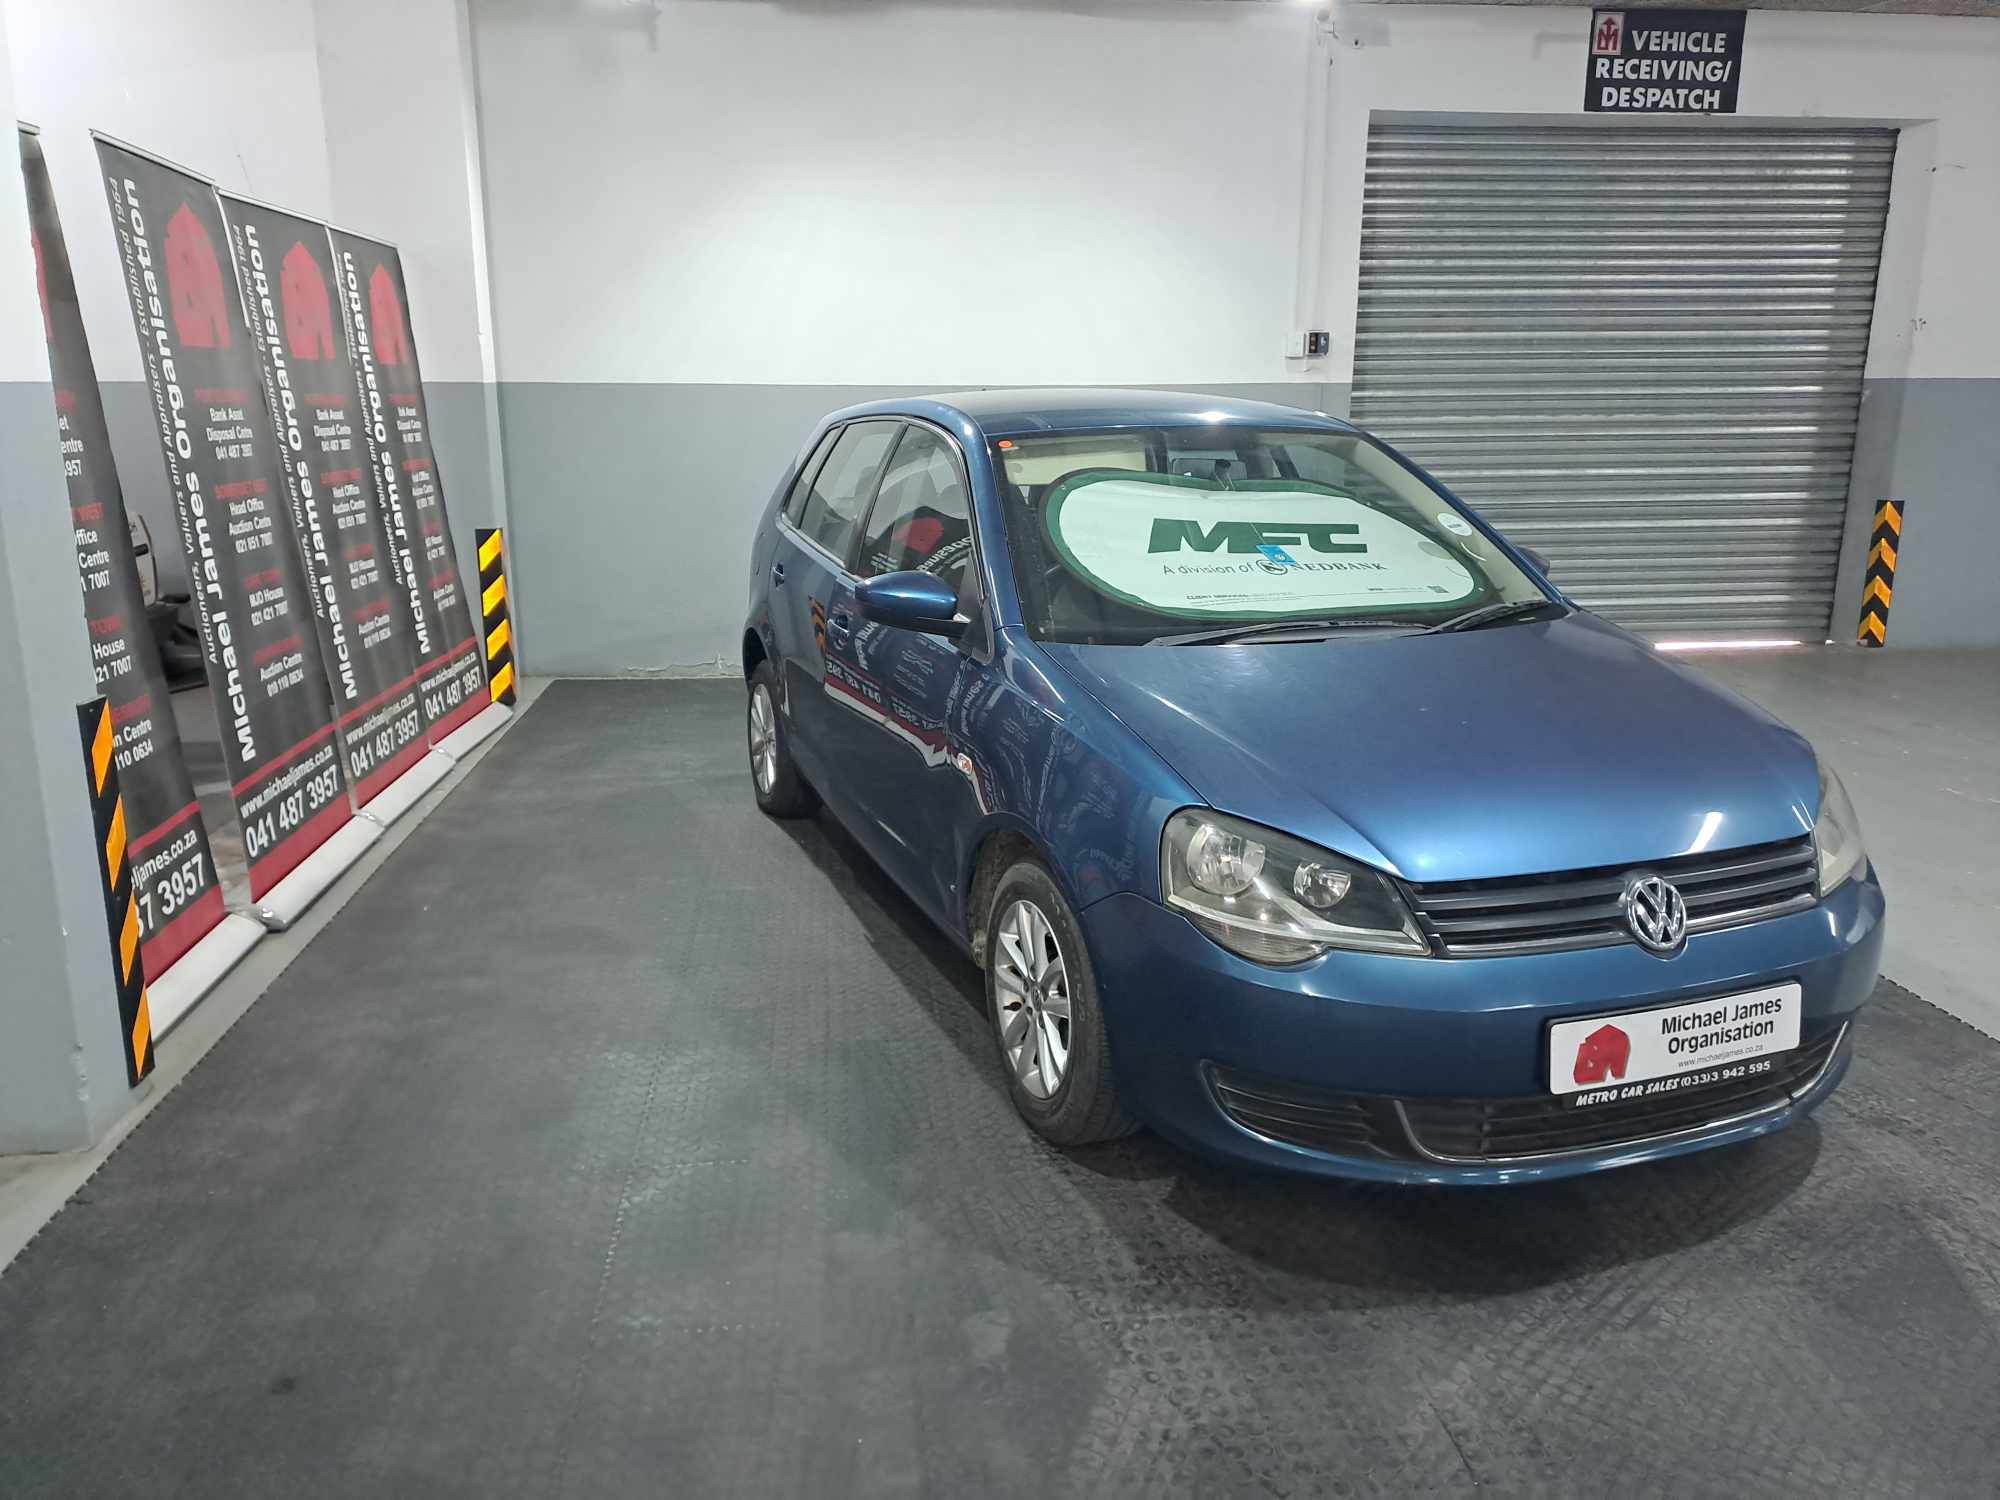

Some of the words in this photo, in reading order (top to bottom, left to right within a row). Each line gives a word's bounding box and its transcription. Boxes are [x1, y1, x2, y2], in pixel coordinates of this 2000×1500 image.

[1631, 30, 1727, 54] VEHICLE
[1595, 58, 1733, 83] RECEIVING/
[1600, 87, 1721, 110] DESPATCH
[119, 229, 150, 336] Established
[123, 178, 192, 460] Organisation
[245, 224, 302, 452] Organisation
[343, 252, 387, 443] Organisation
[148, 352, 173, 448] Appraisers
[60, 437, 84, 453] entre
[279, 444, 292, 473] and
[64, 459, 82, 477] 957
[166, 450, 181, 486] and
[288, 476, 304, 528] Valuers
[296, 461, 329, 567] James
[381, 451, 407, 541] James
[76, 529, 98, 546] ffice
[175, 490, 195, 555] Valuers
[185, 471, 223, 600] James
[1148, 518, 1368, 553] MFC
[79, 550, 110, 568] Centre
[88, 570, 111, 590] 7007
[1163, 564, 1174, 575] A
[1178, 562, 1236, 575] division
[1239, 562, 1254, 574] of
[399, 548, 431, 655] Michael
[92, 639, 125, 660] House
[319, 575, 358, 700] Michael
[110, 655, 132, 677] 7007
[211, 611, 256, 763] Michael
[425, 691, 445, 720] 041
[446, 680, 461, 706] 487
[463, 666, 481, 696] 3957
[123, 719, 152, 742] Centre
[133, 738, 154, 762] 0634
[351, 742, 375, 777] 041
[375, 728, 395, 759] 487
[395, 709, 419, 745] 3957
[246, 812, 277, 858] 041
[279, 789, 304, 831] 487
[307, 764, 339, 810] 3957
[157, 852, 205, 916] 3957
[1661, 1006, 1727, 1035] Michael
[1732, 998, 1782, 1022] James
[1668, 1020, 1774, 1054] Organisation
[1575, 1090, 1618, 1107] METRO
[1621, 1085, 1643, 1100] CAR
[1645, 1078, 1680, 1095] SALES
[1722, 1066, 1745, 1080] 942
[1749, 1060, 1771, 1074] 595
